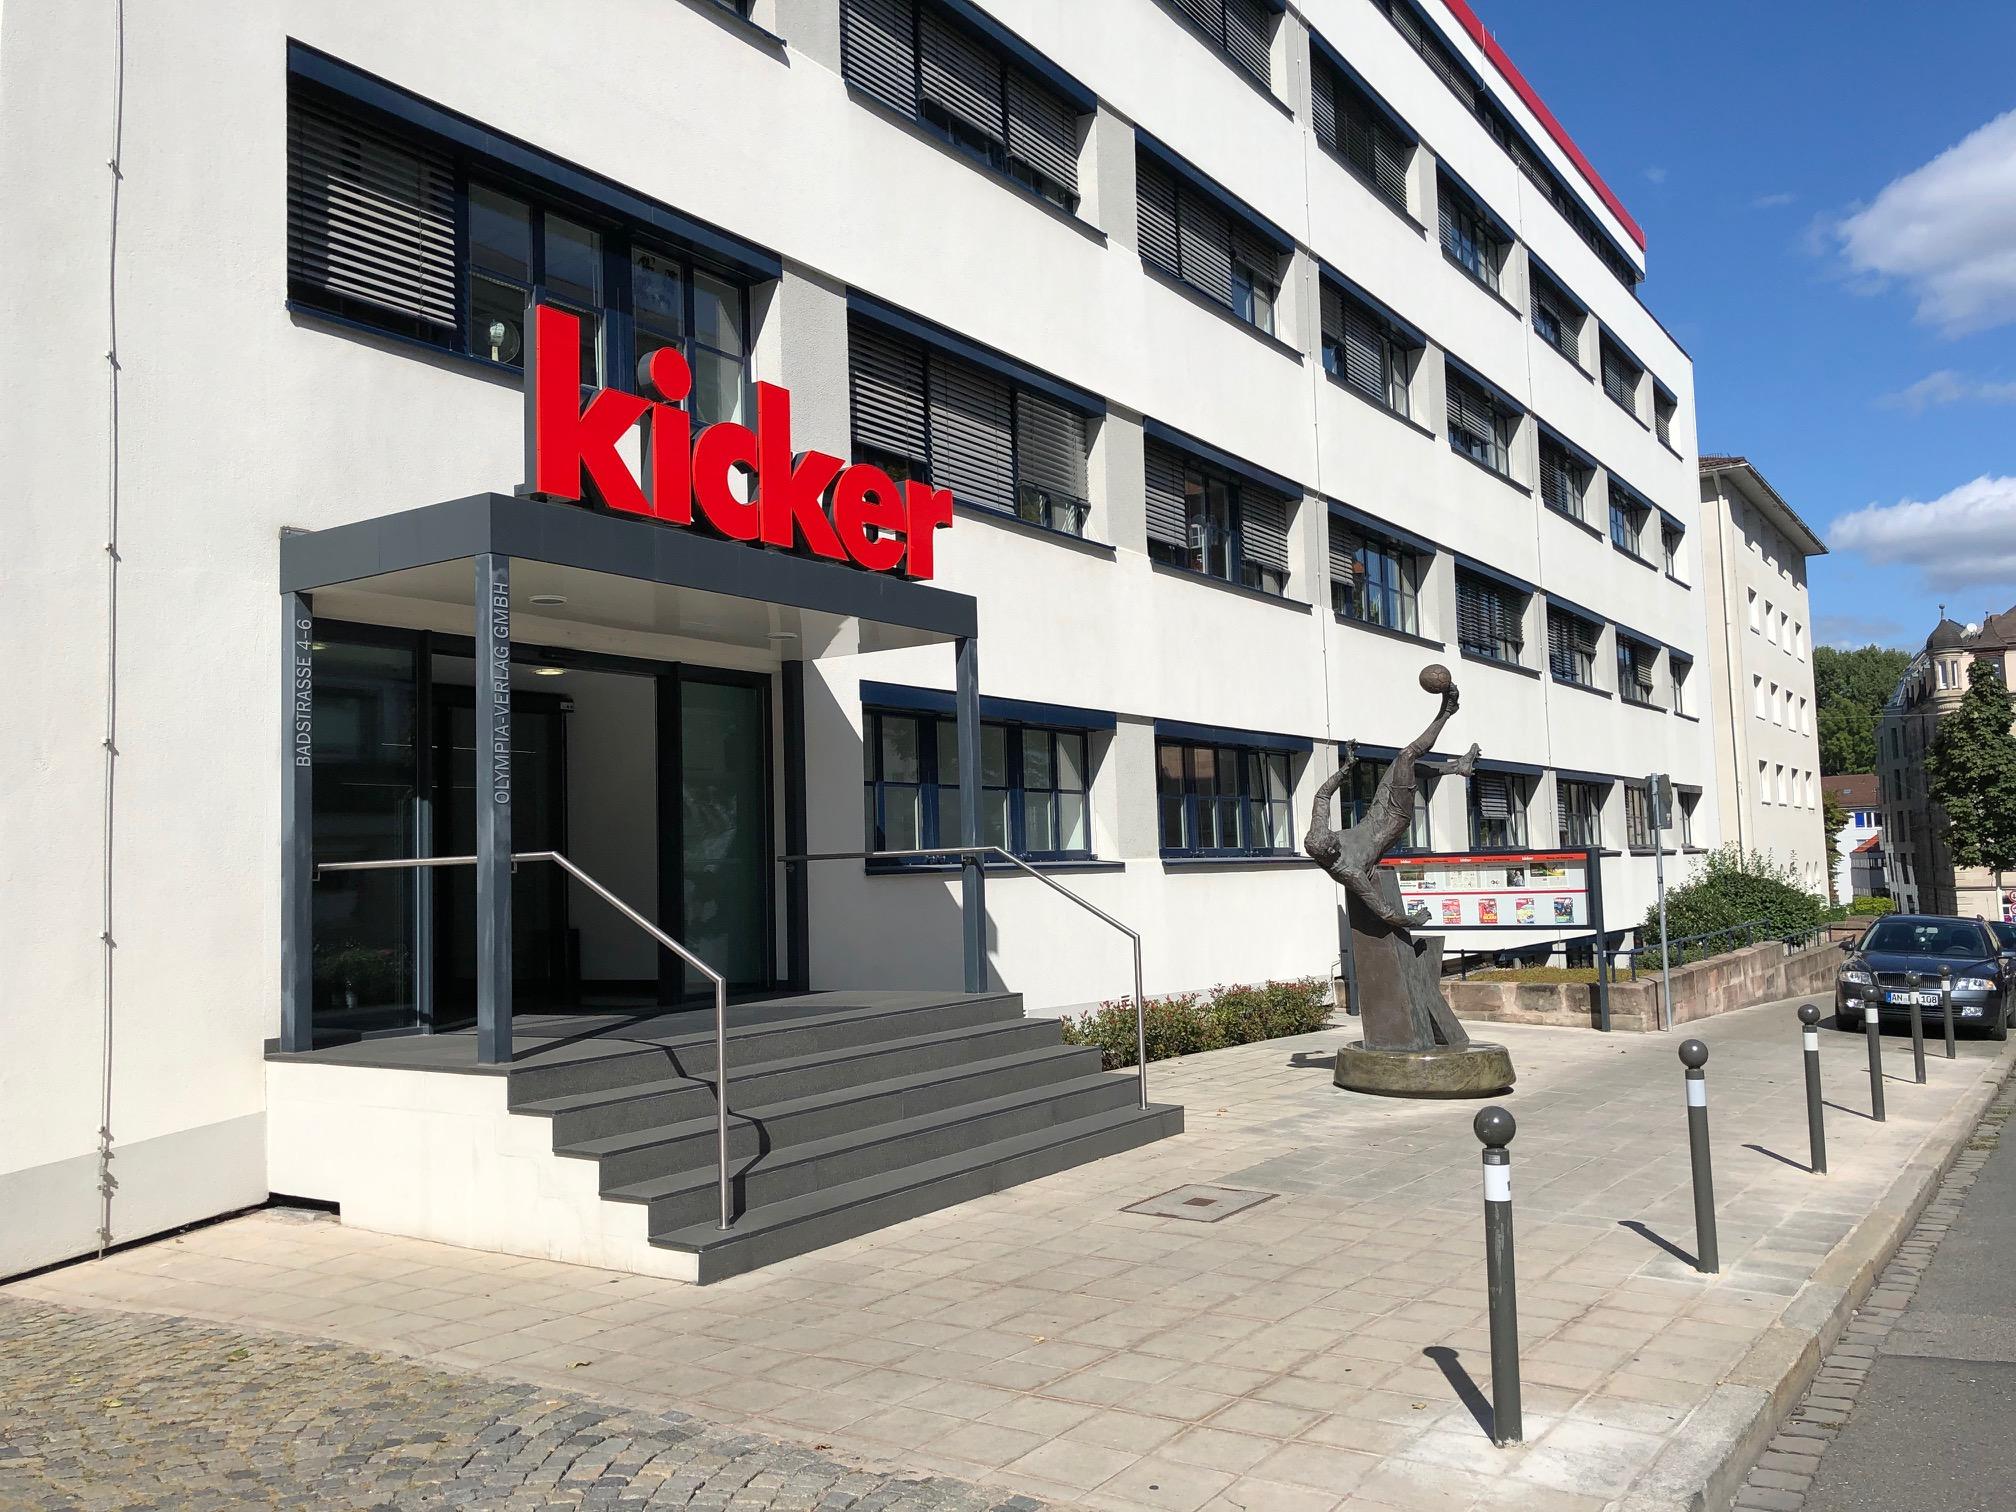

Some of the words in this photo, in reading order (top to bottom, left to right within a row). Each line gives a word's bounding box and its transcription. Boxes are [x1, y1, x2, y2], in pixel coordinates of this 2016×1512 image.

[535, 304, 953, 580] kicker
[296, 619, 312, 652] 4-6
[494, 582, 509, 639] GMBH
[296, 657, 312, 767] BADSTRASSE
[494, 647, 511, 805] OLYMPIA-VERLAG
[1891, 993, 1903, 1002] AN
[1921, 995, 1937, 1004] 108
